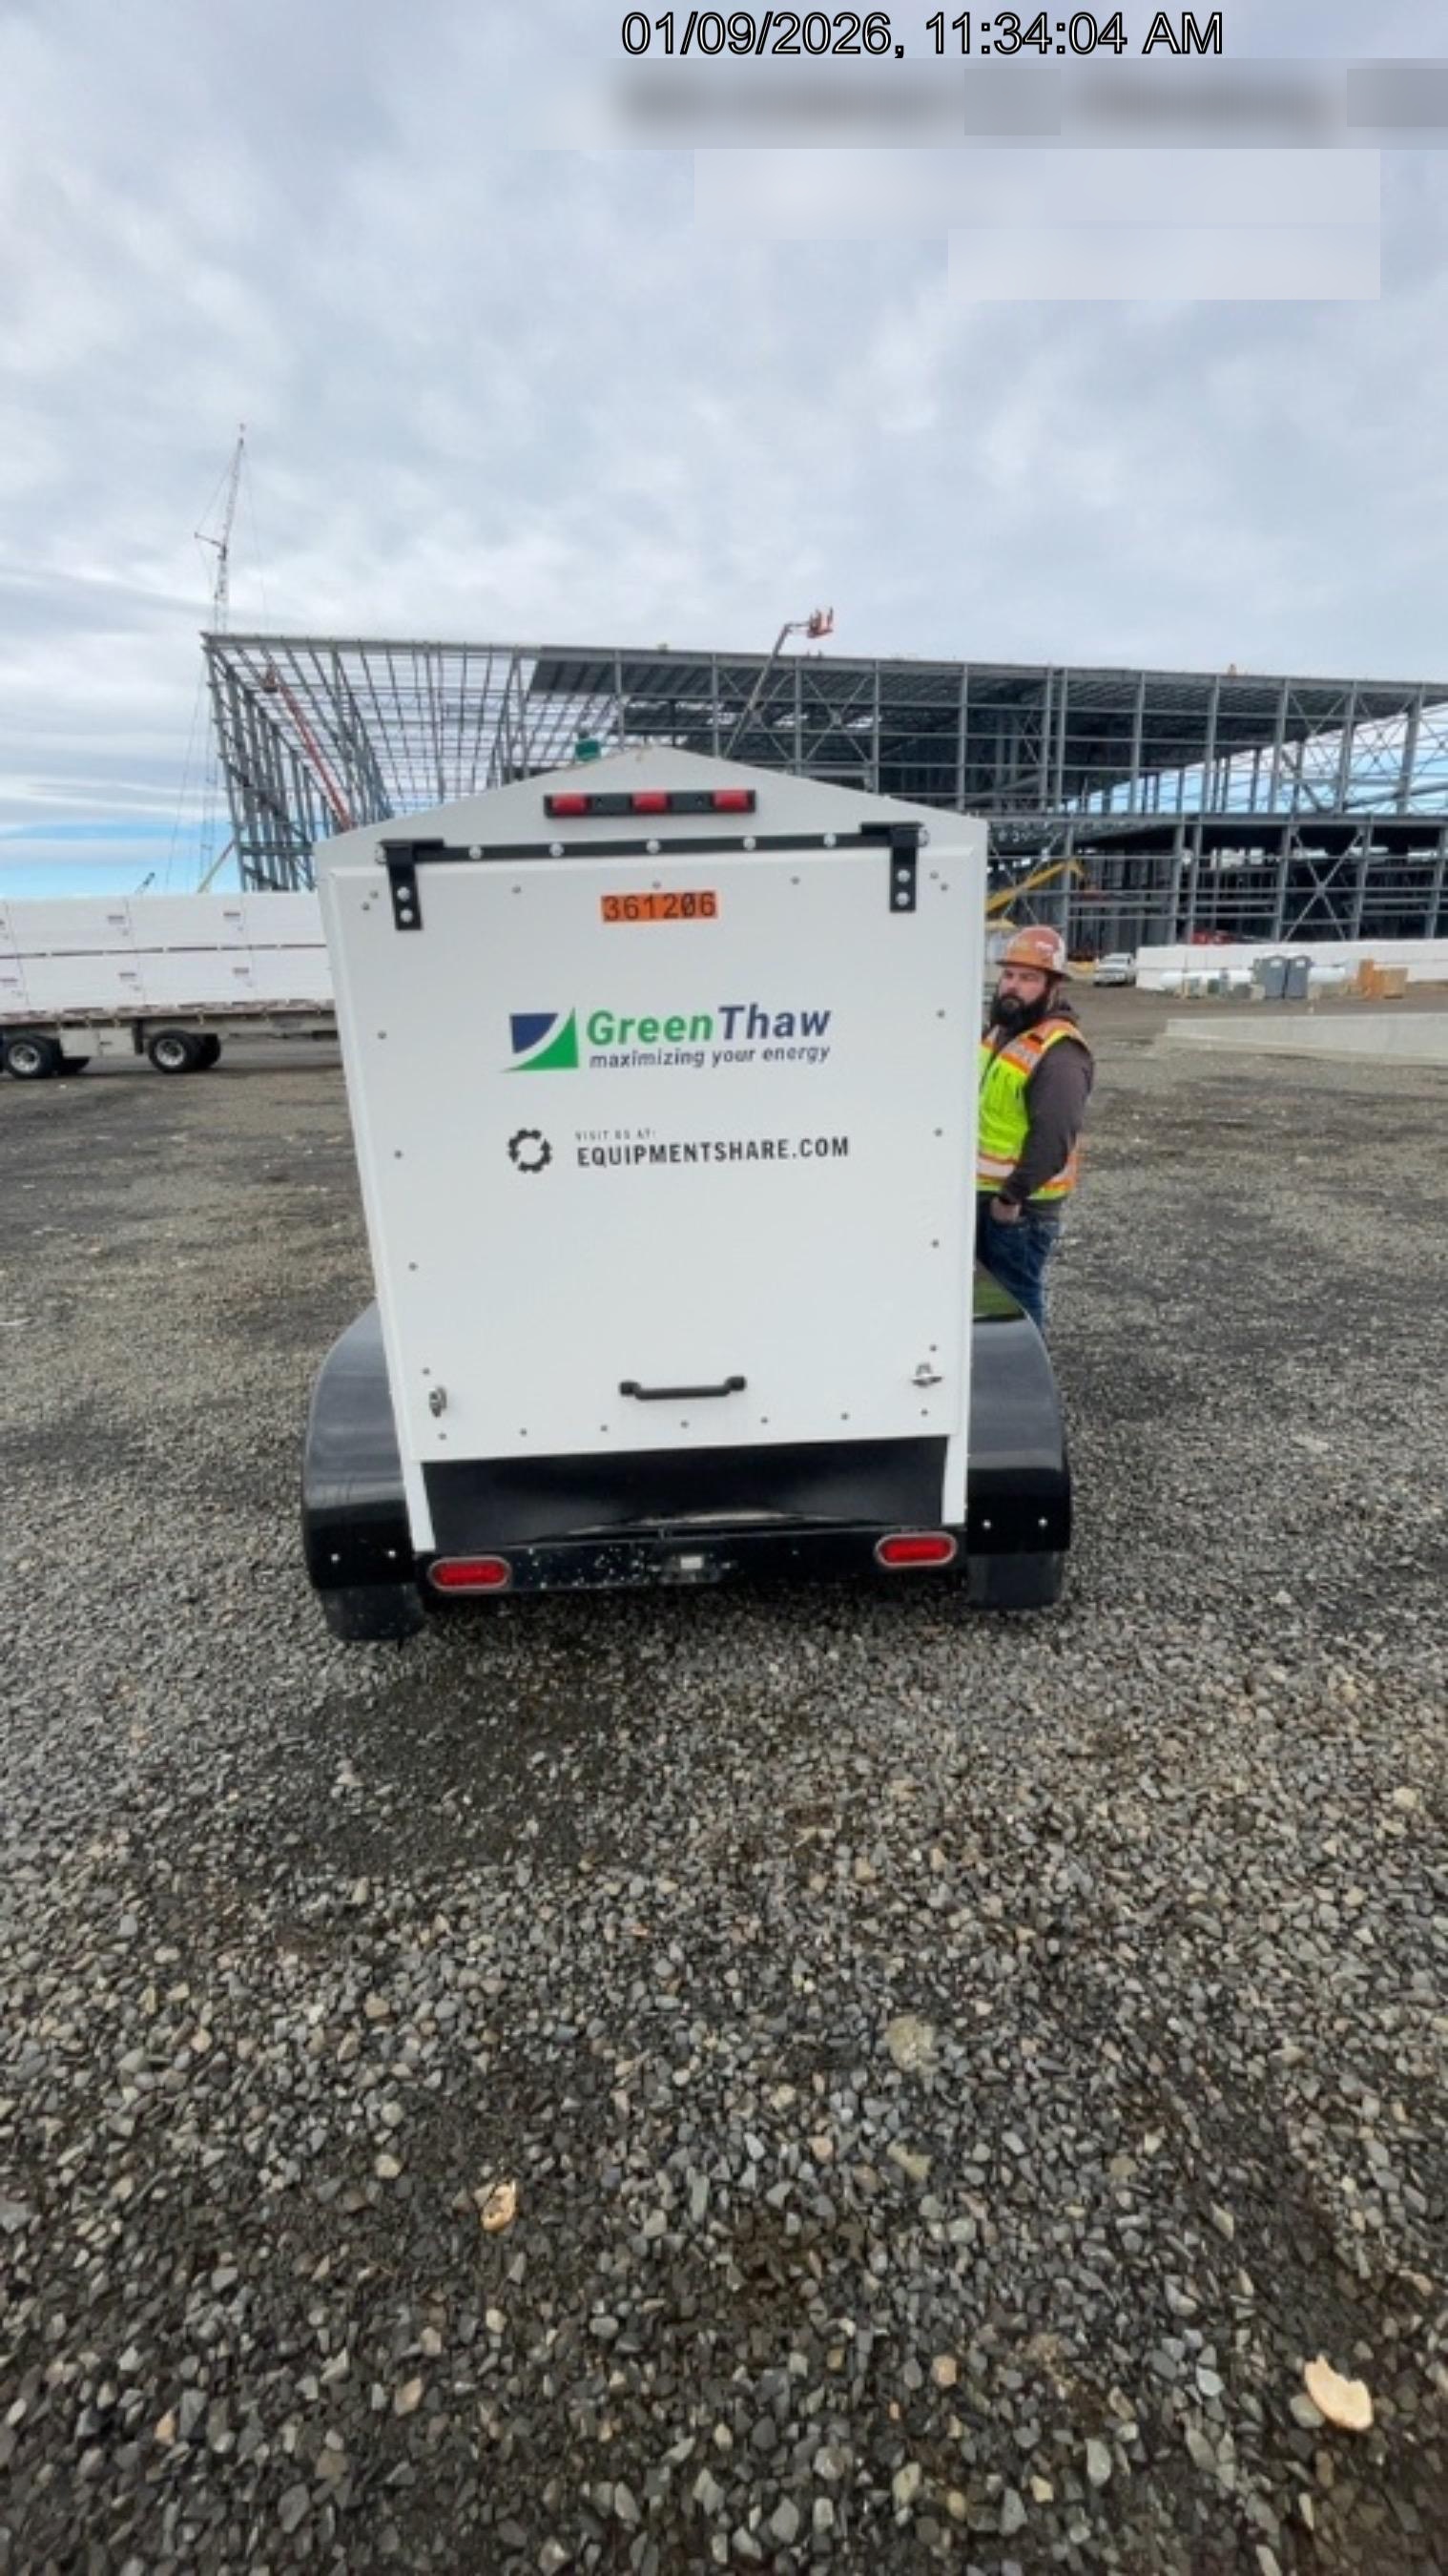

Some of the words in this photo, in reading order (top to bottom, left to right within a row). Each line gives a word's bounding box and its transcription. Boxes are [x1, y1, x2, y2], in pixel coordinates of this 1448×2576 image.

[602, 891, 717, 923] 361206
[589, 1049, 706, 1069] maximizing
[712, 1048, 757, 1068] your
[761, 1045, 832, 1065] energy
[576, 1135, 850, 1168] EQUIPMENTSHARE.COM
